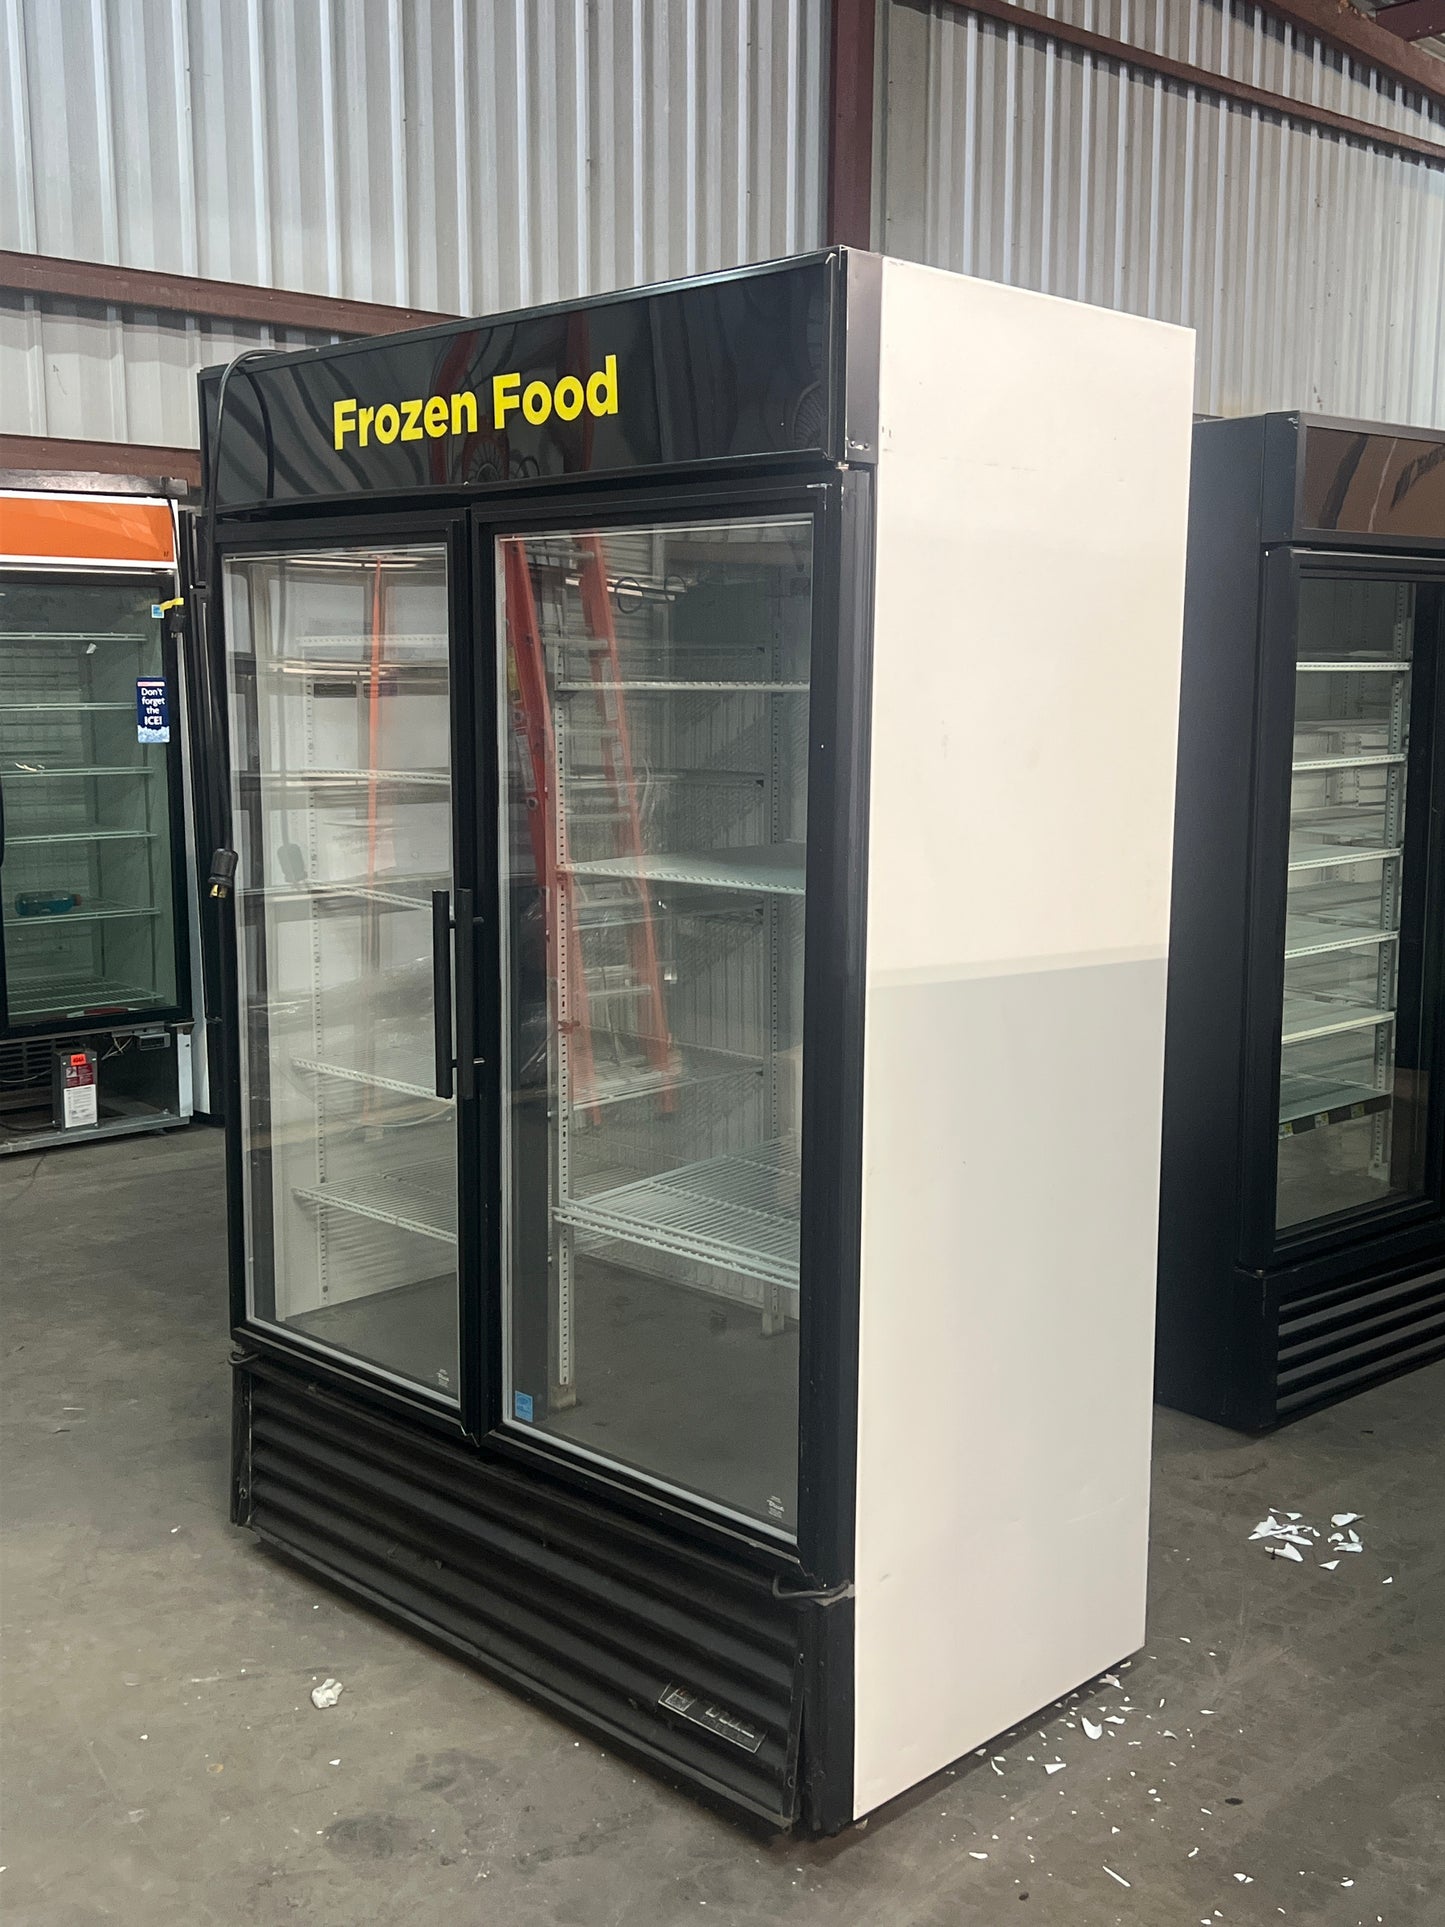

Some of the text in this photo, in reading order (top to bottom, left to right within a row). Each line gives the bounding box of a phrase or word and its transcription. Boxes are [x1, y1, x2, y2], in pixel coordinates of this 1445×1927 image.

[333, 354, 618, 450] Frozen Food
[141, 688, 163, 696] Don't
[141, 697, 166, 707] forget
[146, 706, 160, 715] the
[144, 716, 163, 726] ICE!
